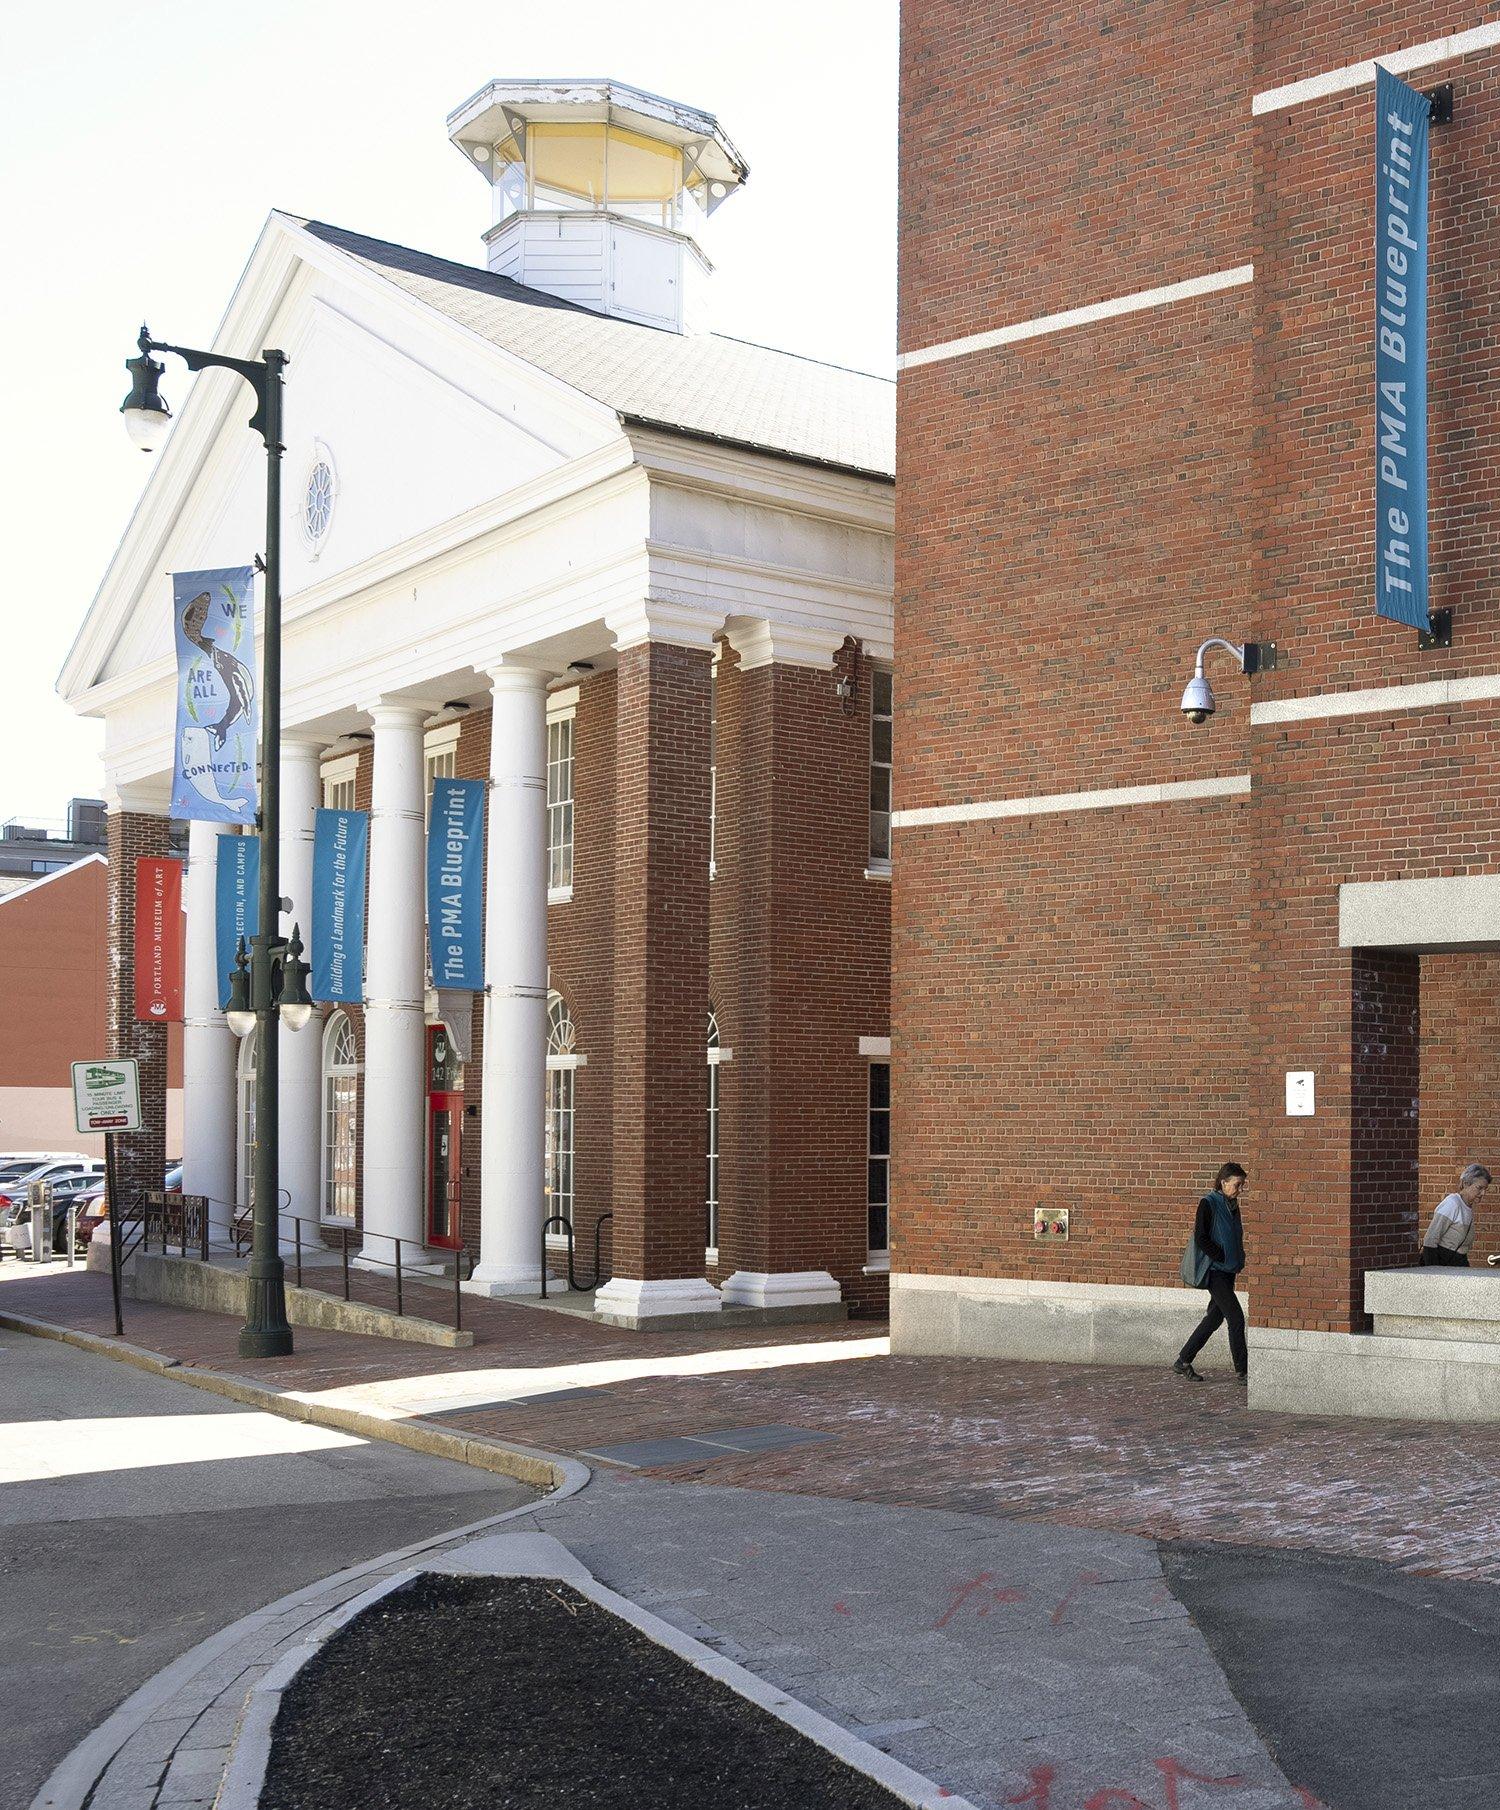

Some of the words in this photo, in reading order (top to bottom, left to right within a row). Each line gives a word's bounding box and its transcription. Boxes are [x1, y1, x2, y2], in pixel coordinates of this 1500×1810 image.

[1380, 110, 1418, 363] Blueprint
[1380, 382, 1407, 490] PMA
[1384, 507, 1412, 593] The
[221, 603, 247, 619] WE
[188, 668, 212, 684] ARE
[193, 682, 217, 698] ALL
[333, 816, 348, 852] Future
[441, 788, 469, 887] Blueprint
[237, 841, 246, 876] CAMPUS
[332, 853, 346, 871] the
[155, 867, 164, 887] ART
[236, 878, 245, 896] AND
[333, 872, 346, 889] for
[154, 900, 163, 941] MUSEUM
[331, 890, 345, 942] Landmark
[441, 893, 462, 938] PMA
[335, 943, 344, 952] a
[443, 944, 464, 980] The
[153, 945, 162, 995] PORTLAND
[331, 952, 346, 995] Building
[432, 1067, 444, 1081] 142
